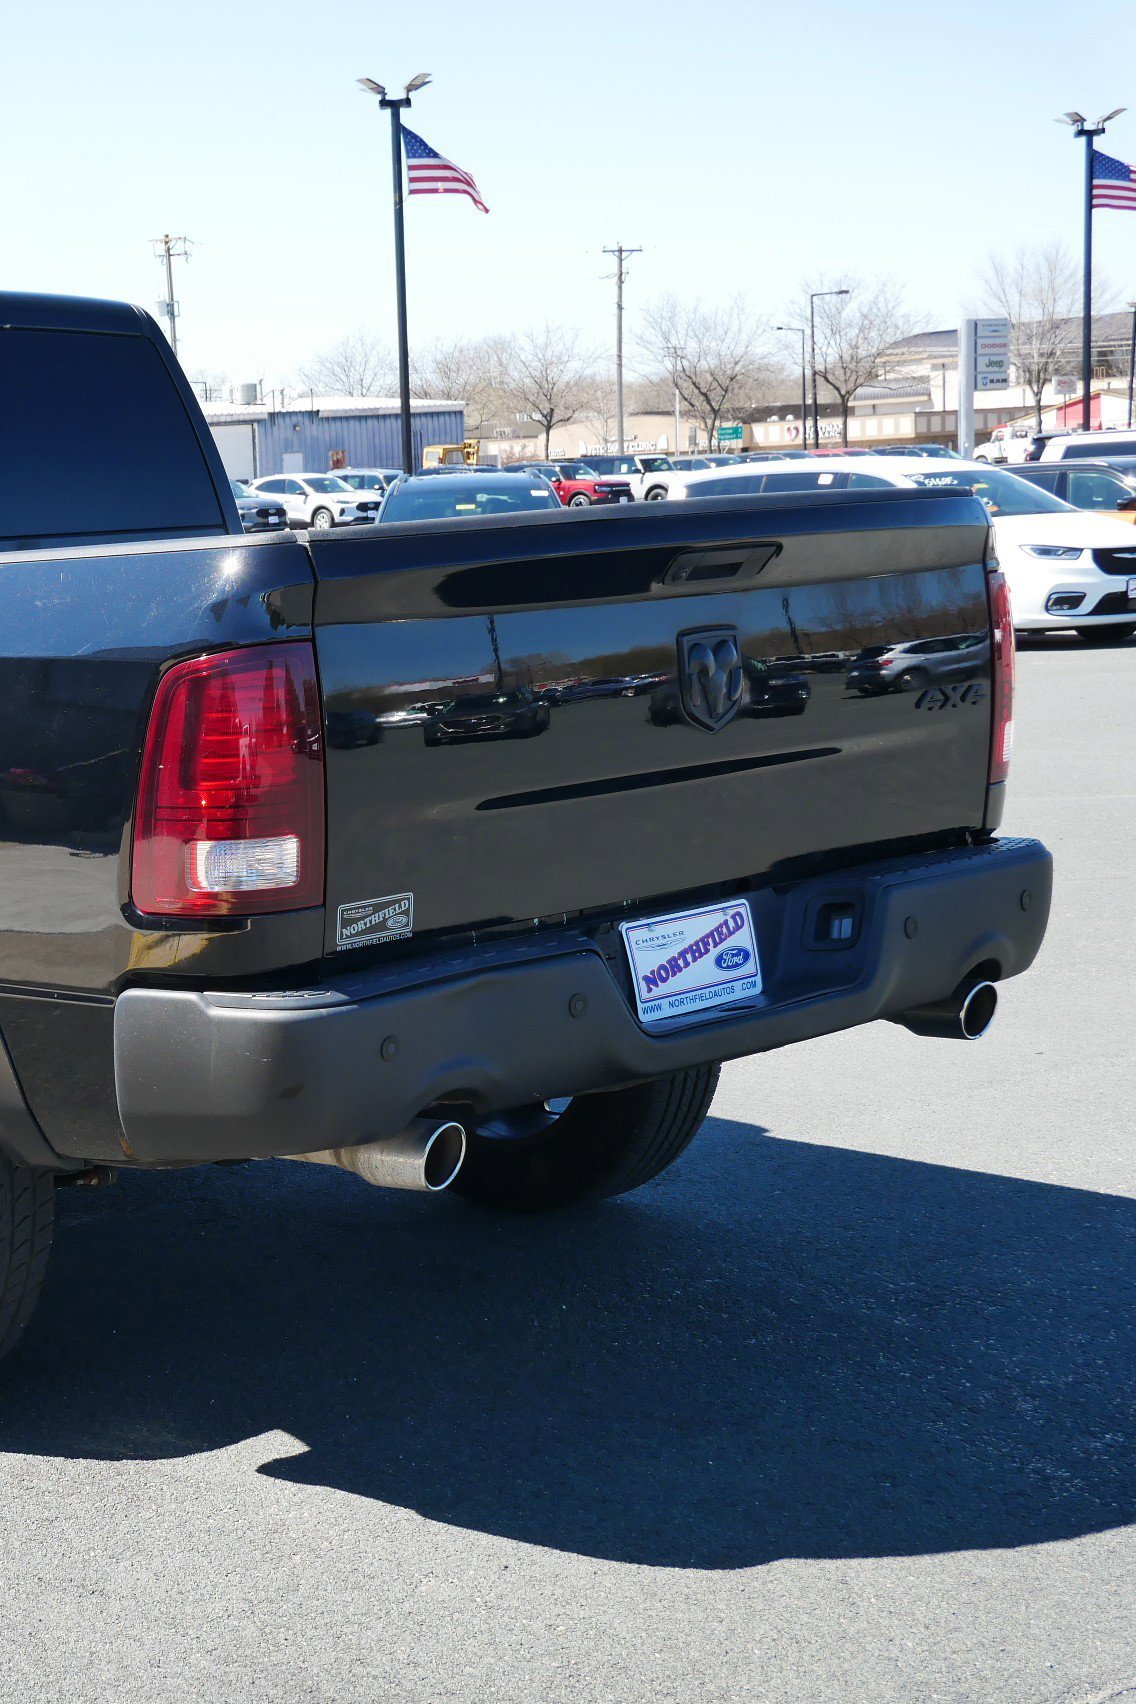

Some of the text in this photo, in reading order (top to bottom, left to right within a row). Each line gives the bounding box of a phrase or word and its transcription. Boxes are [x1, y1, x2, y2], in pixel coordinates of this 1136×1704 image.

[985, 357, 1004, 369] Jeep
[342, 900, 409, 938] NORTHFIELD
[635, 930, 685, 945] CHRYSLER
[642, 911, 745, 994] NORTHFIELD
[721, 950, 744, 967] Ford
[668, 985, 735, 1009] NORTHFIELDAUTOS
